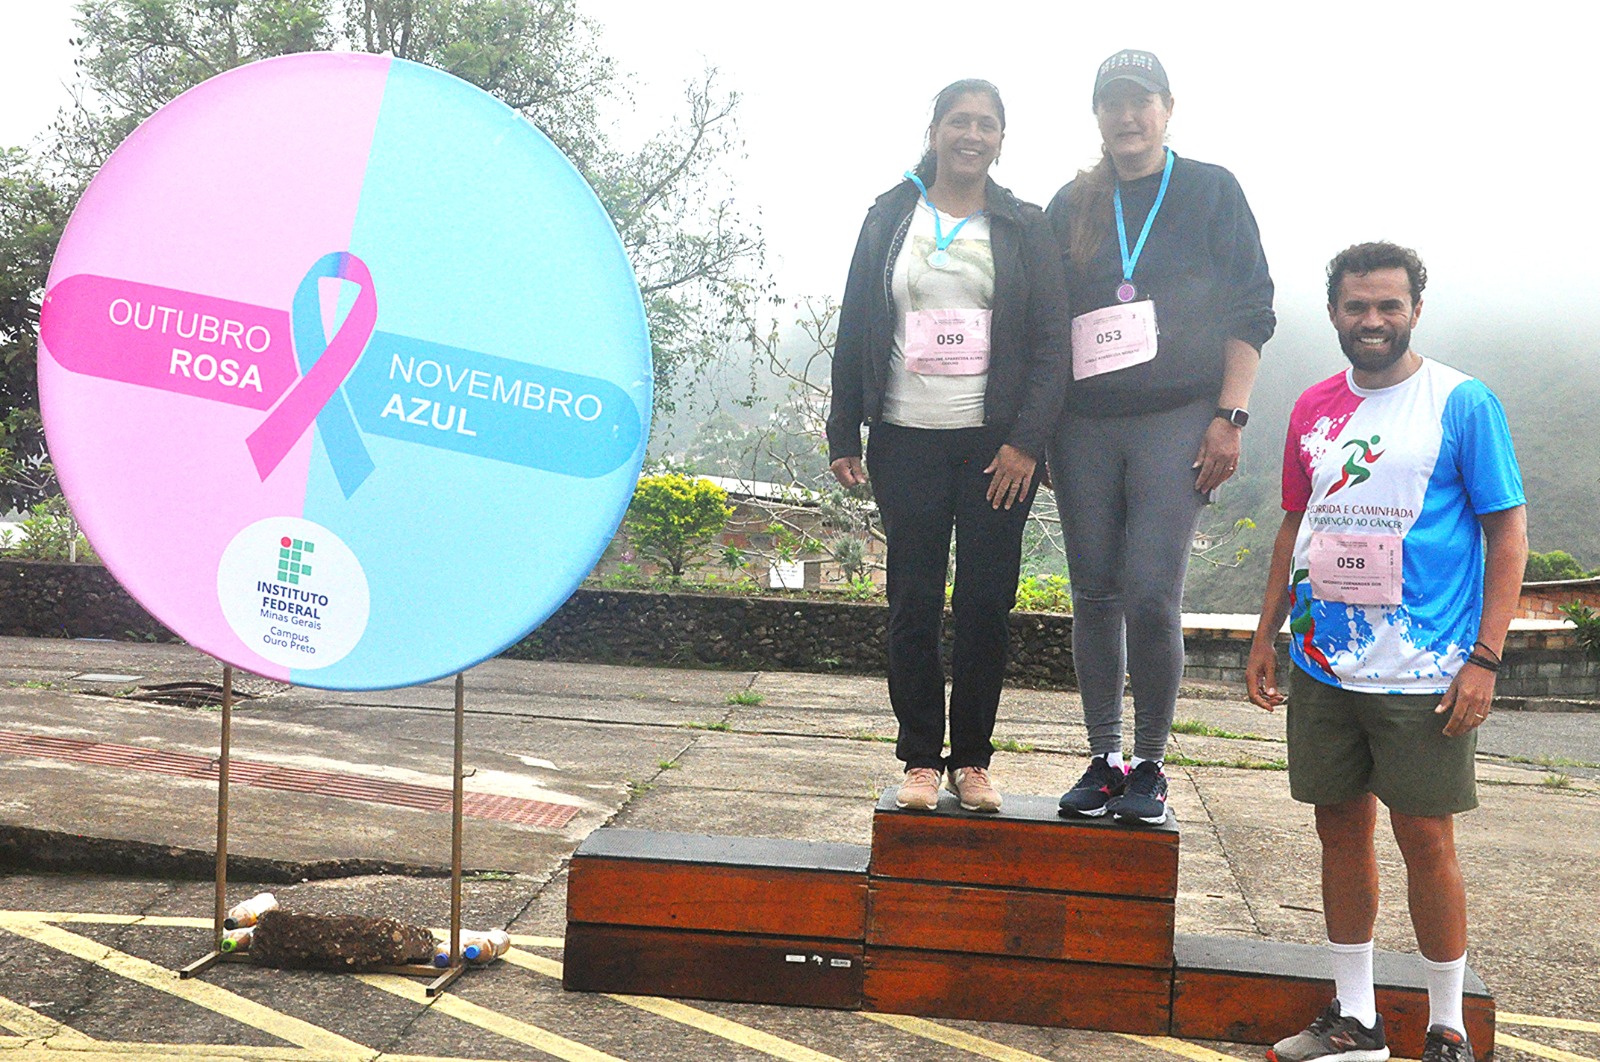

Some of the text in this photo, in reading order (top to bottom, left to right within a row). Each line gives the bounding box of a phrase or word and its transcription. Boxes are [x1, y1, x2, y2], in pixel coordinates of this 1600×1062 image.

[108, 299, 271, 352] OUTUBRO
[936, 333, 964, 345] 059
[1096, 330, 1122, 344] 053
[169, 348, 263, 392] ROSA
[389, 353, 602, 421] NOVEMBRO
[380, 393, 477, 437] AZUL
[1344, 504, 1350, 515] E
[1351, 504, 1414, 519] CAMINHADA
[1355, 518, 1368, 527] AO
[1370, 517, 1403, 530] CÂNCER
[1337, 557, 1366, 570] 058
[256, 581, 329, 607] INSTITUTO
[262, 596, 321, 620] FEDERAL
[260, 608, 322, 631] Minas Gerais
[263, 634, 316, 654] Ouro Preto
[270, 626, 310, 644] Campus
